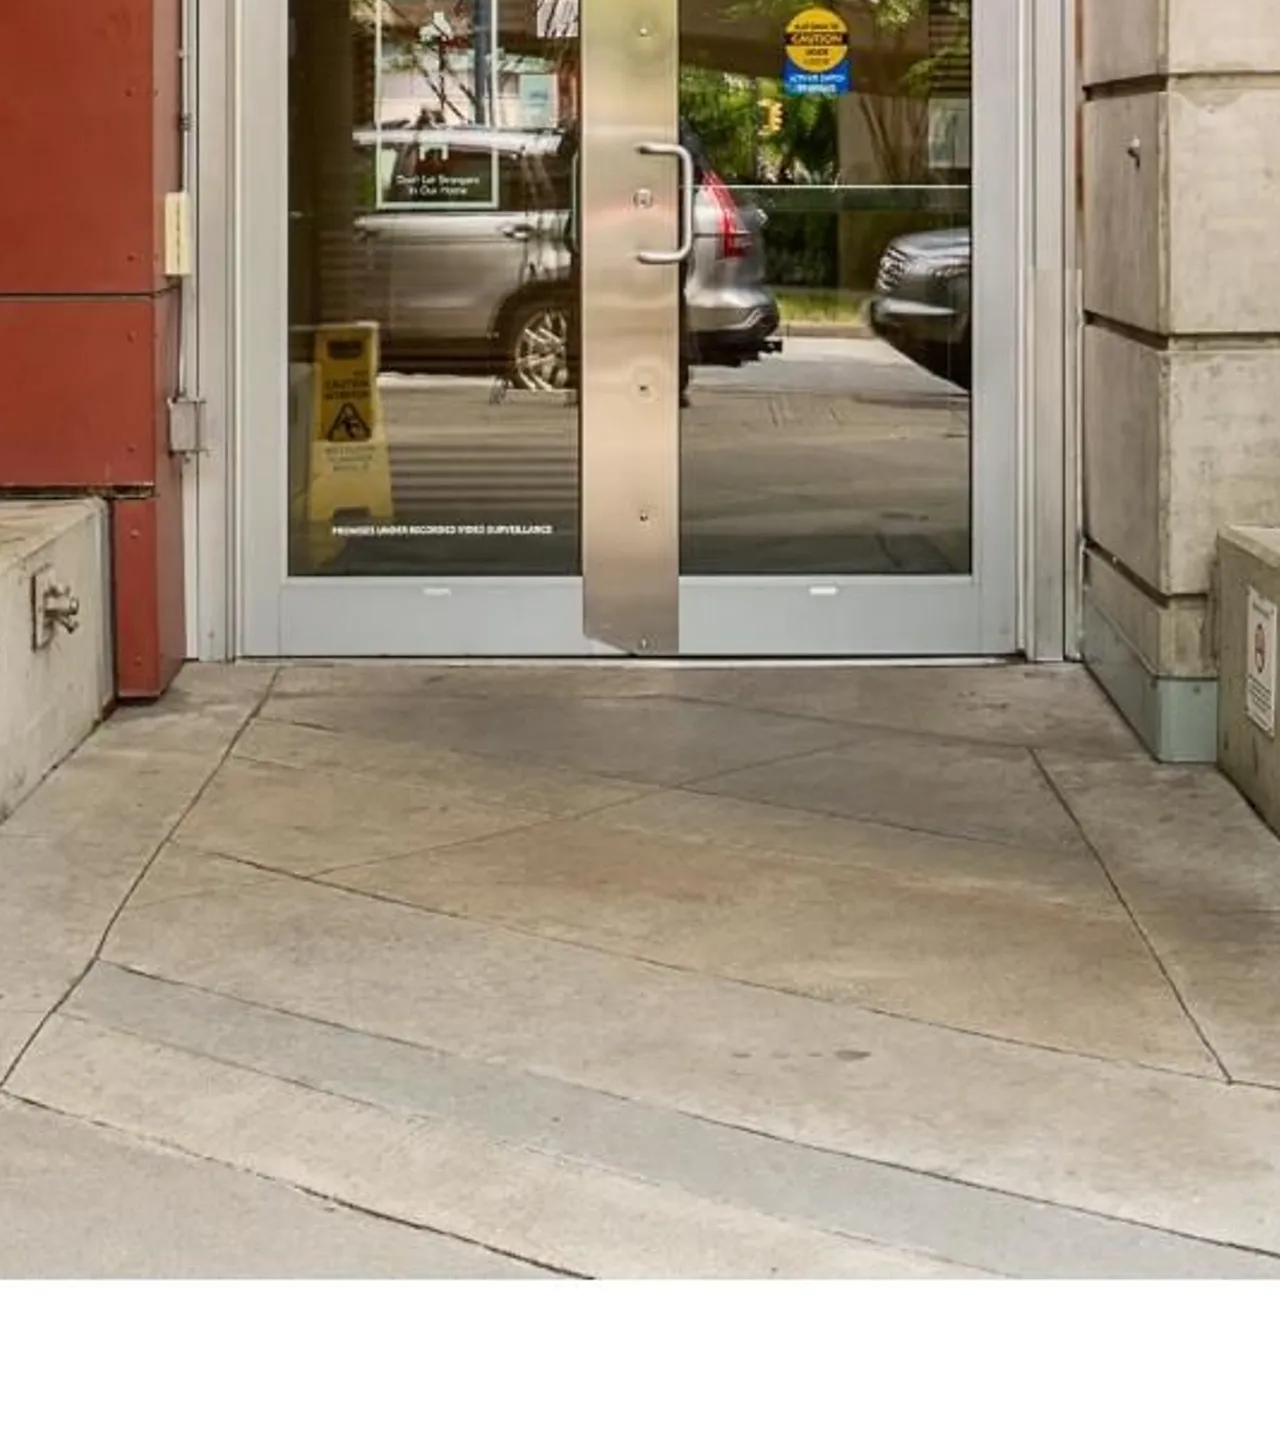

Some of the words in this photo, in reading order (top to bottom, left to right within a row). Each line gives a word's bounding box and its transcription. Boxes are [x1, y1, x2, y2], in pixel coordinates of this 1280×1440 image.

[790, 33, 843, 44] CAUTION
[419, 185, 438, 195] Our
[440, 185, 468, 195] Home
